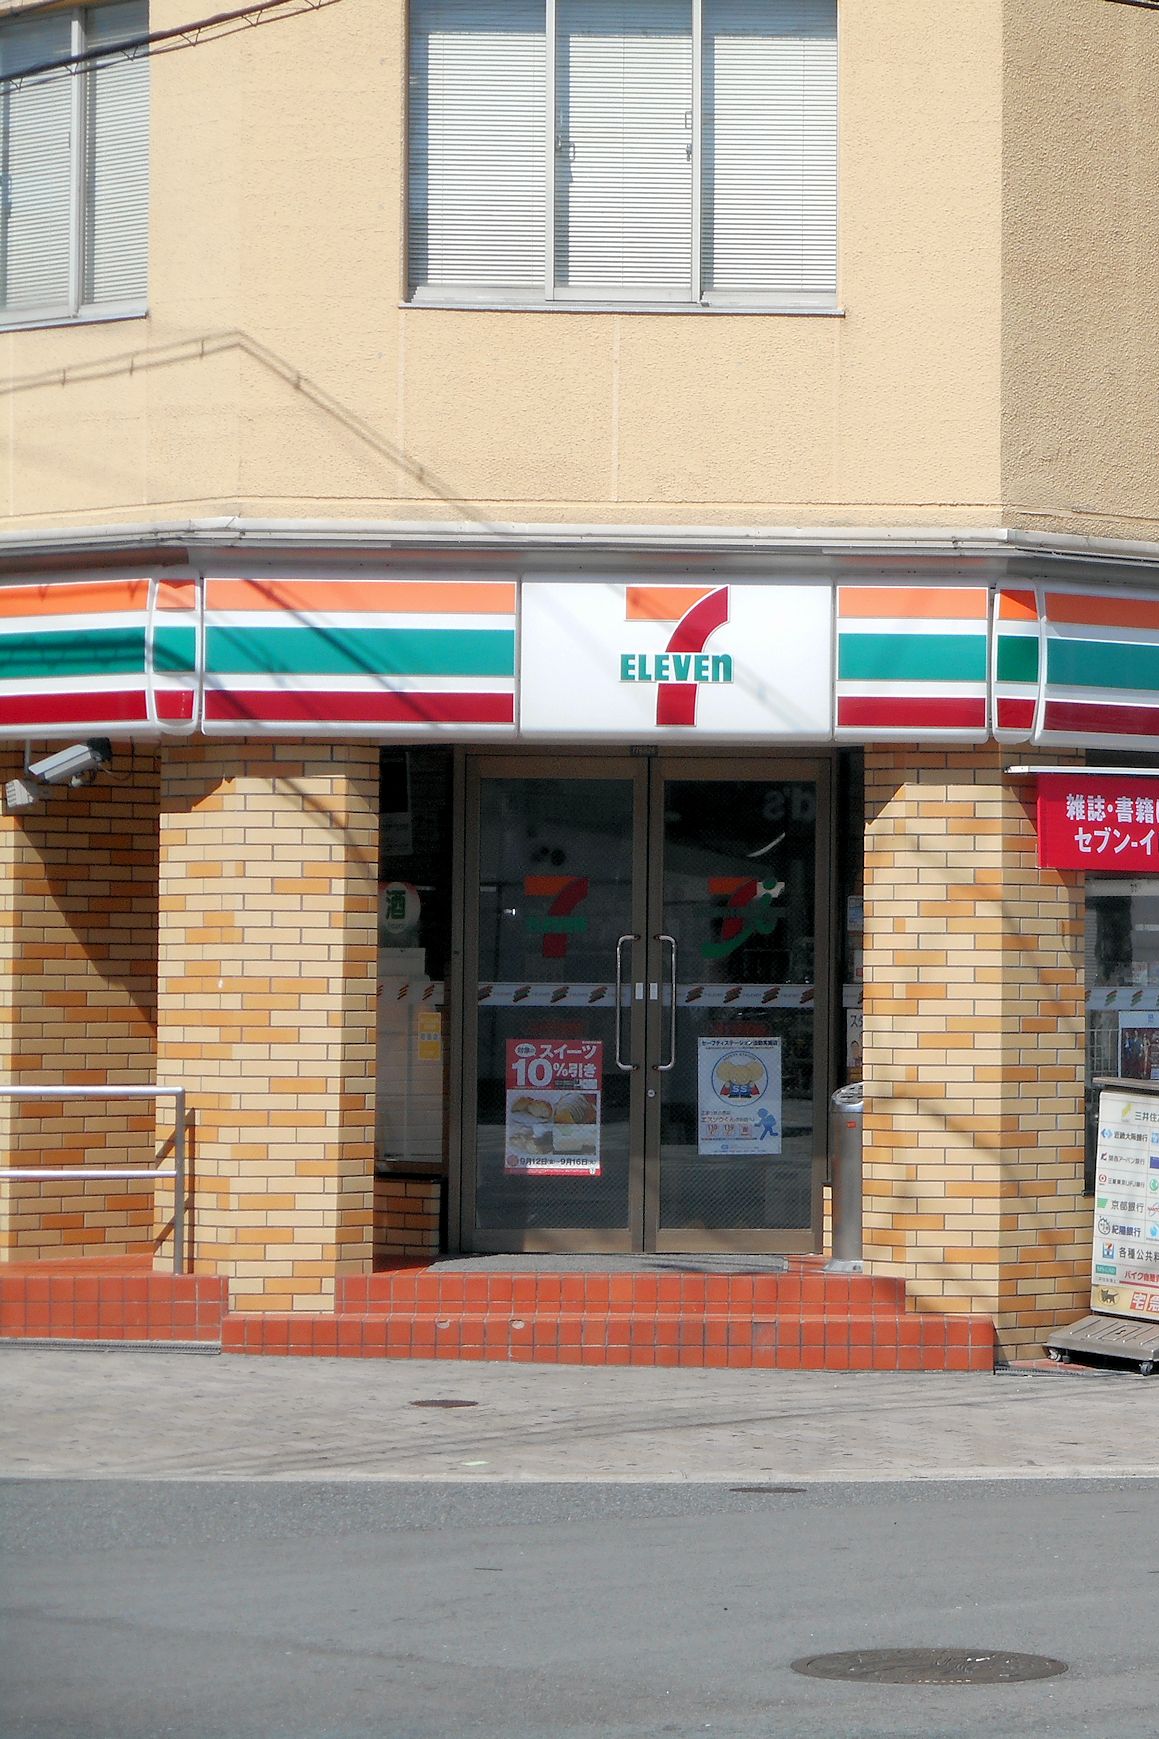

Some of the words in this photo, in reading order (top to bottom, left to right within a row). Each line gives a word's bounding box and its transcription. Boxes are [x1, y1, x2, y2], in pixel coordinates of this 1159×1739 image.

[386, 889, 407, 920] 酒
[540, 1044, 597, 1060] スイーツ
[732, 1085, 748, 1093] SS
[1114, 1131, 1148, 1142] 近畿大阪銀行
[1111, 1200, 1144, 1213] 京都銀行
[1111, 1224, 1141, 1237] 紀陽銀行
